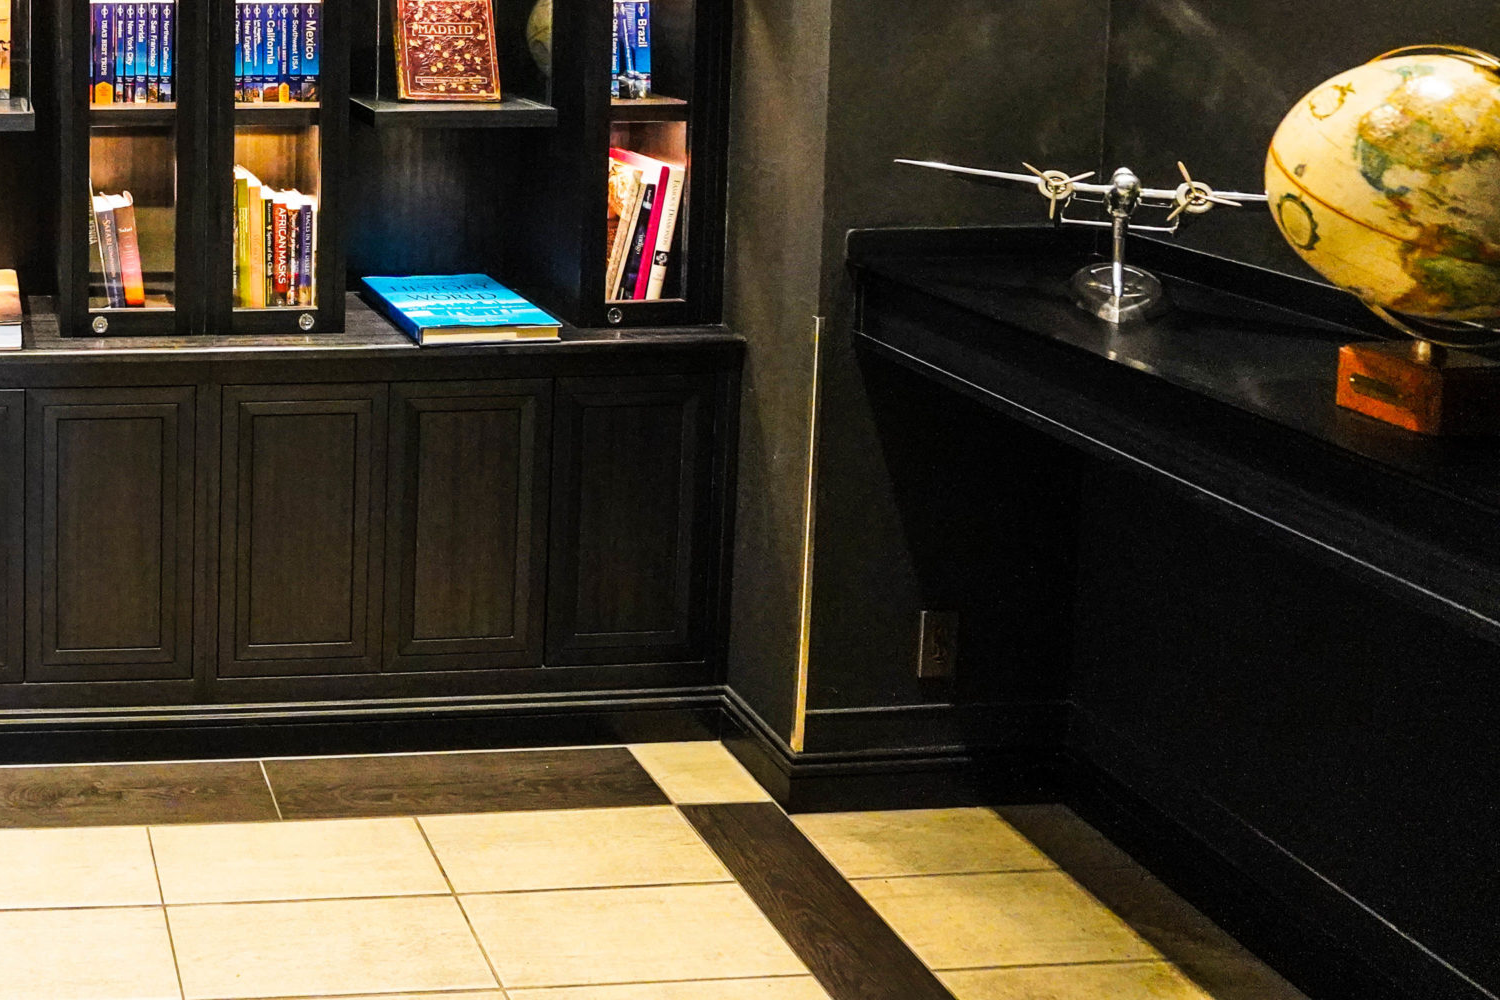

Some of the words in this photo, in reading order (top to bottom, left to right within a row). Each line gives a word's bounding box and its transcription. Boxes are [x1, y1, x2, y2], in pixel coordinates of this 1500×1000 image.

[266, 20, 276, 65] California
[305, 20, 316, 60] Mexico
[418, 24, 474, 35] MADRID
[638, 19, 648, 48] Brazil
[125, 52, 134, 66] City
[243, 36, 251, 62] England
[291, 55, 299, 70] USA
[103, 219, 113, 245] SAFARI
[278, 208, 287, 247] AFRICAN
[277, 248, 287, 285] MASKS
[390, 282, 489, 293] HISTORY
[406, 293, 497, 301] WORLD
